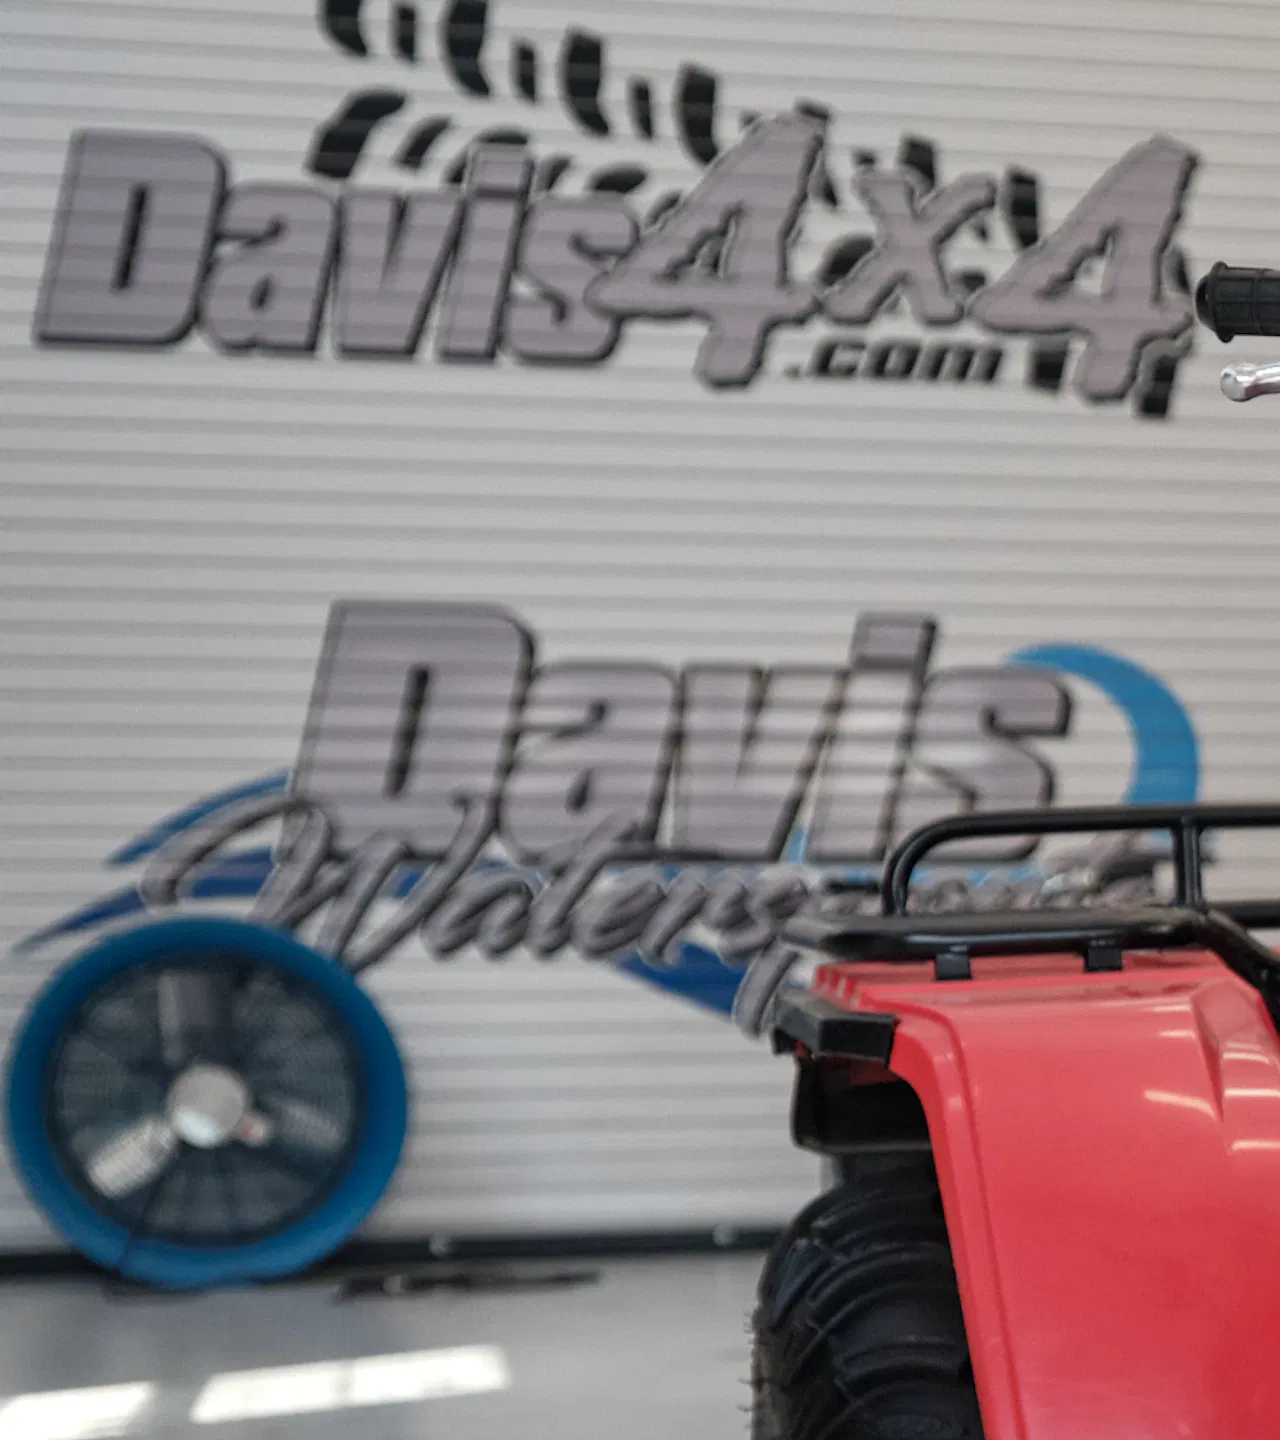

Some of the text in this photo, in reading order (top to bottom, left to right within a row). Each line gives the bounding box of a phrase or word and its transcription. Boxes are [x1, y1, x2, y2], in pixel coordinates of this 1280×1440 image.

[36, 104, 1199, 404] Davis4x4
[783, 333, 1004, 384] .com
[284, 599, 1076, 861] Davis
